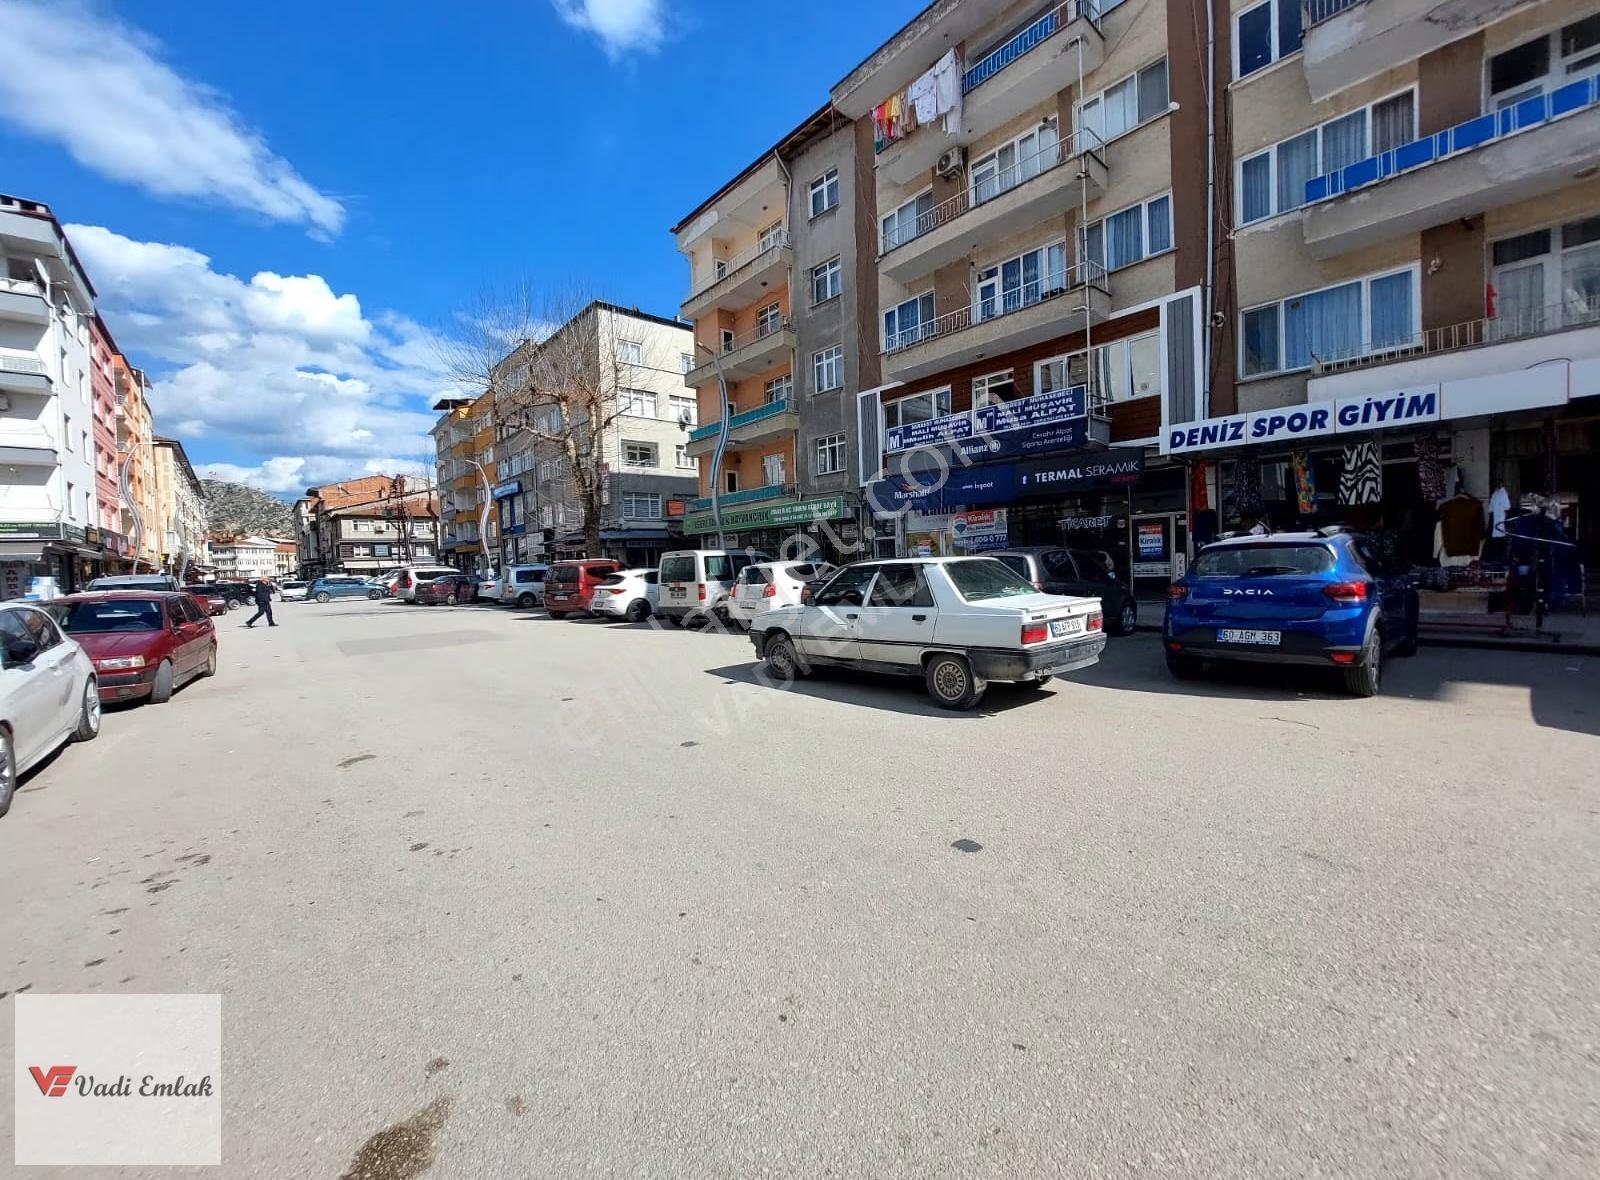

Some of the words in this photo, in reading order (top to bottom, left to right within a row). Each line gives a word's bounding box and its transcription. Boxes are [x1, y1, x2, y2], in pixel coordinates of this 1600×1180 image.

[1031, 403, 1076, 419] ALPAT
[1169, 419, 1246, 448] DENİZ
[1251, 409, 1329, 438] SPOR
[1338, 392, 1436, 427] GİYİM
[960, 443, 989, 457] Allianz
[1034, 467, 1083, 484] TERMAL
[1085, 460, 1139, 477] SERAMİK
[1223, 630, 1234, 640] 60
[1262, 632, 1280, 642] 363
